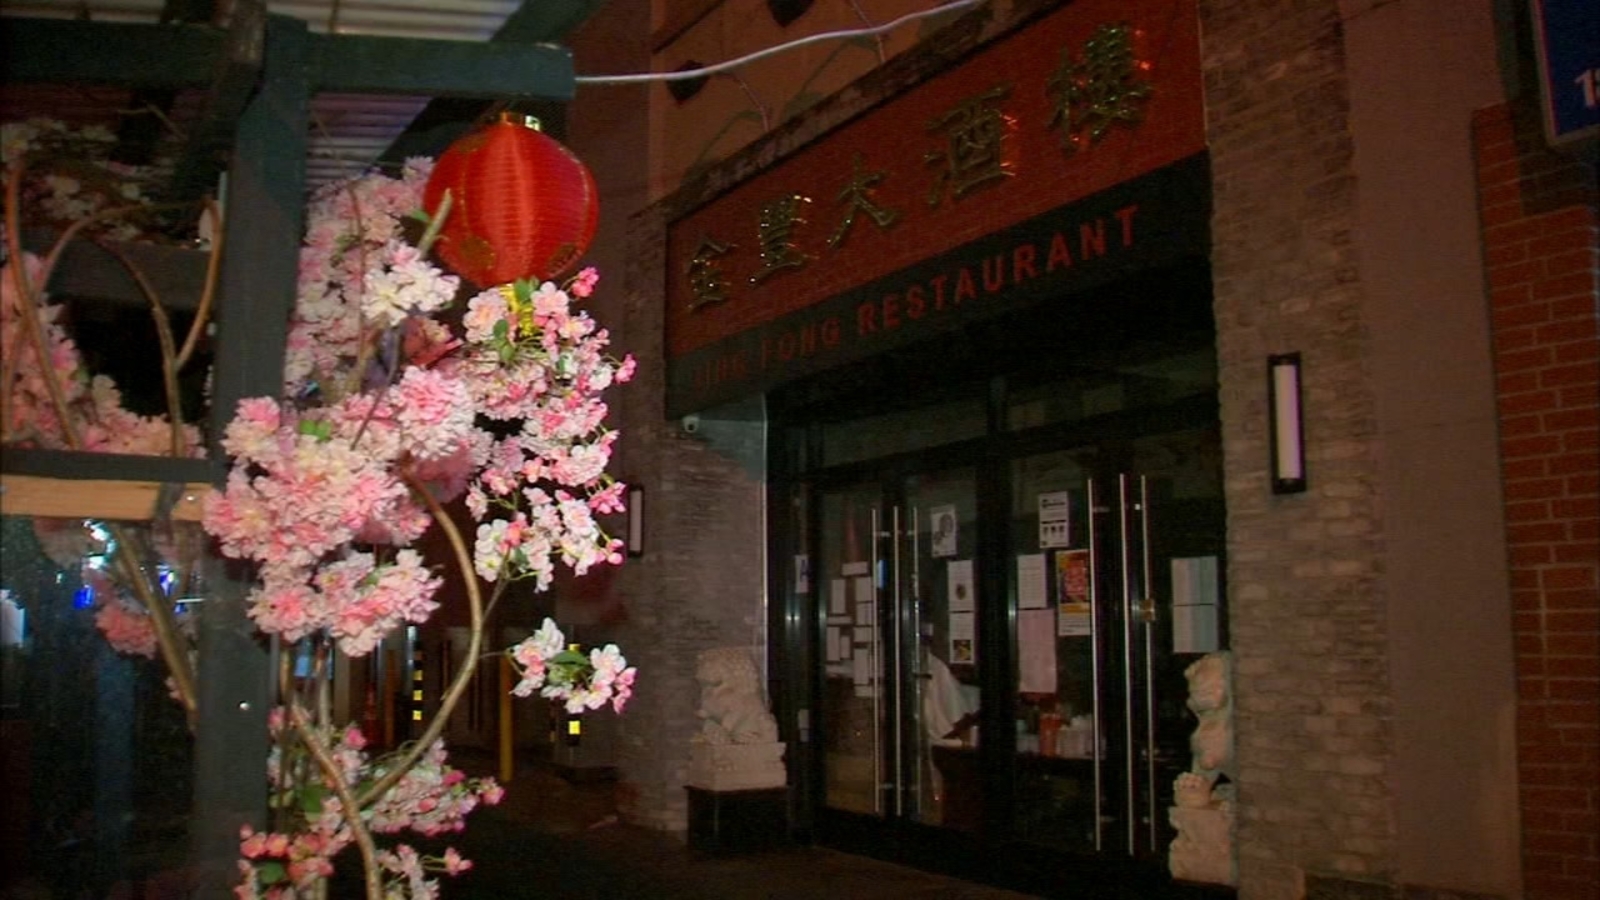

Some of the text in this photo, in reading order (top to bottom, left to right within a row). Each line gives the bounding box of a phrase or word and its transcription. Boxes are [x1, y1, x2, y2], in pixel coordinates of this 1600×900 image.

[1574, 67, 1600, 110] 1
[760, 315, 842, 370] FONG
[856, 203, 1139, 336] RESTAURANT
